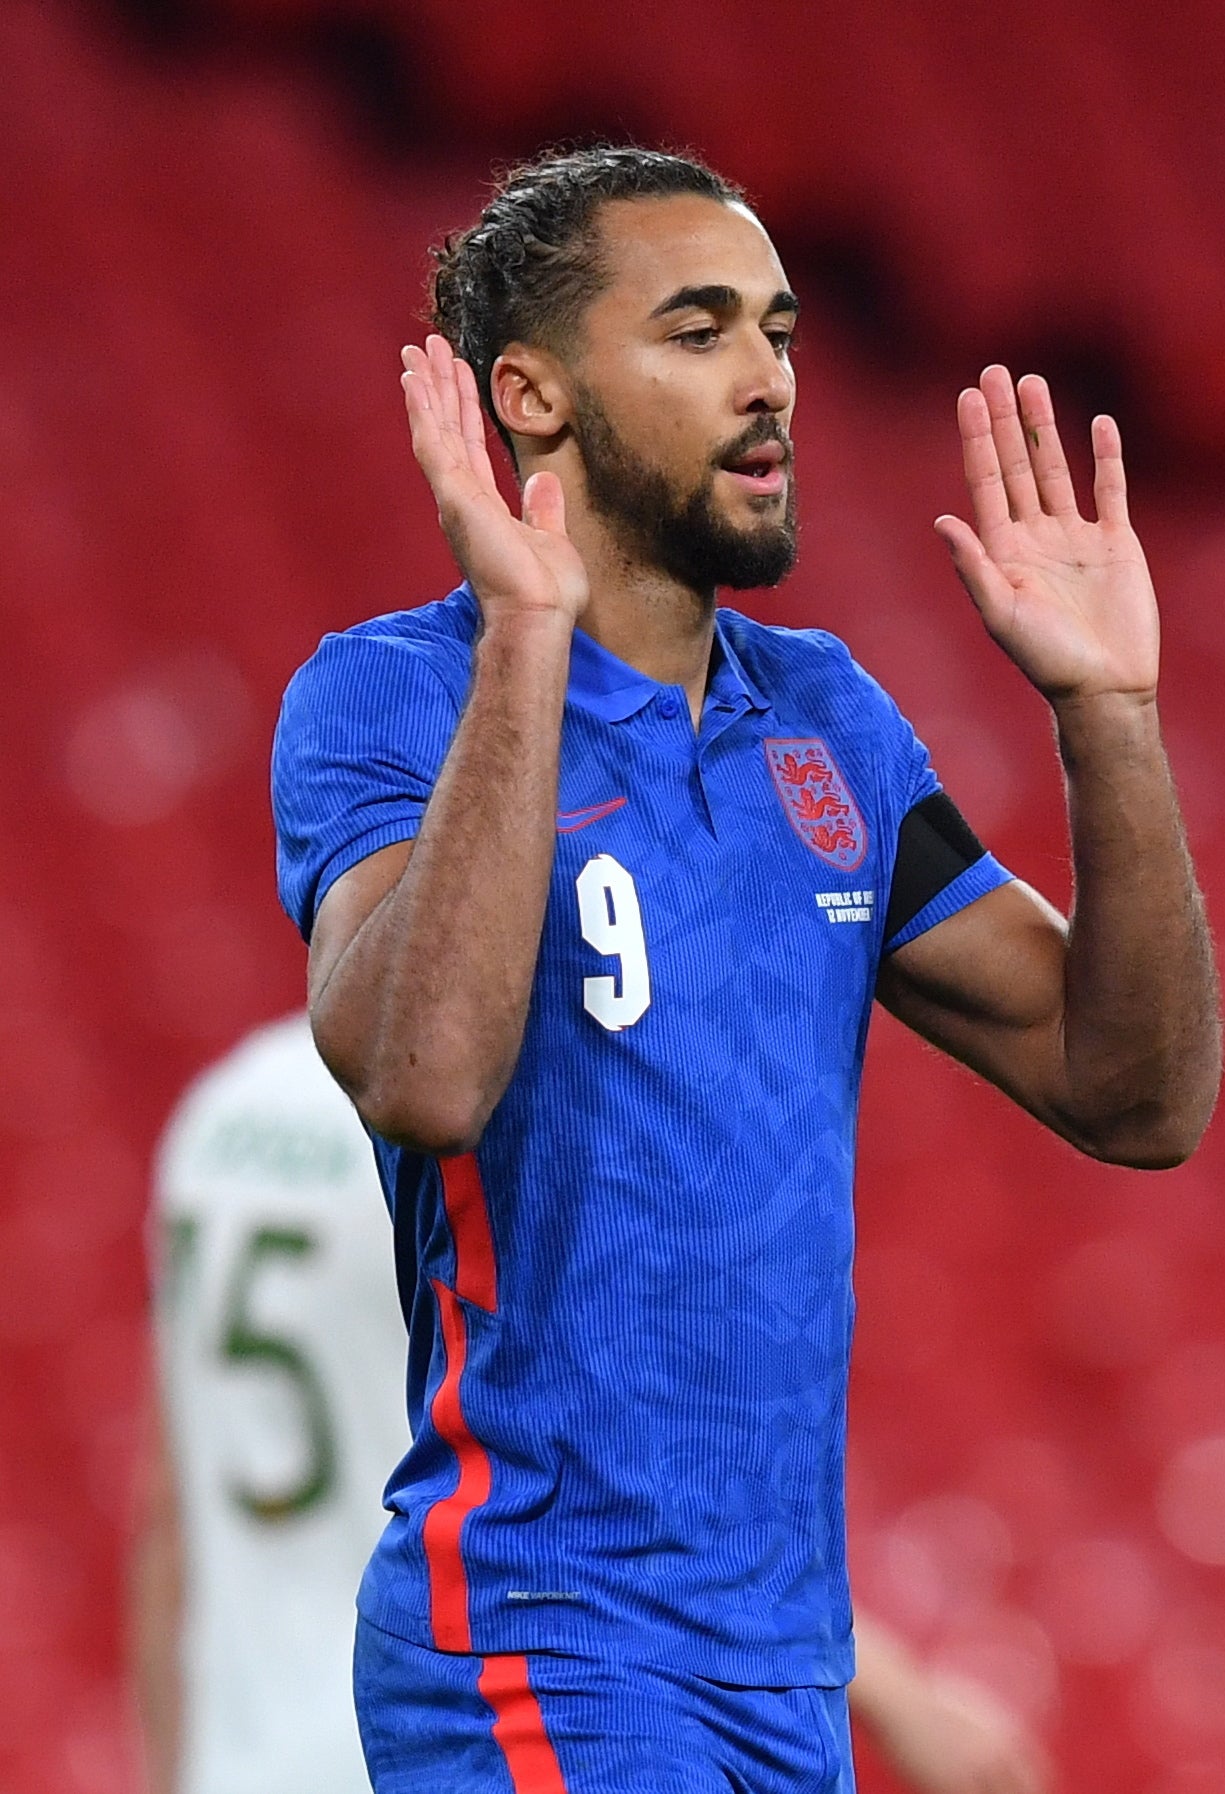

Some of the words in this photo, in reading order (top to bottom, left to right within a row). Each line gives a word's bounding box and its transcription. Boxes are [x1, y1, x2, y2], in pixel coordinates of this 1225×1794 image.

[815, 892, 853, 908] REPUBLIC
[852, 890, 863, 905] OF
[835, 907, 871, 923] NOVEMBER
[574, 853, 652, 1032] 9
